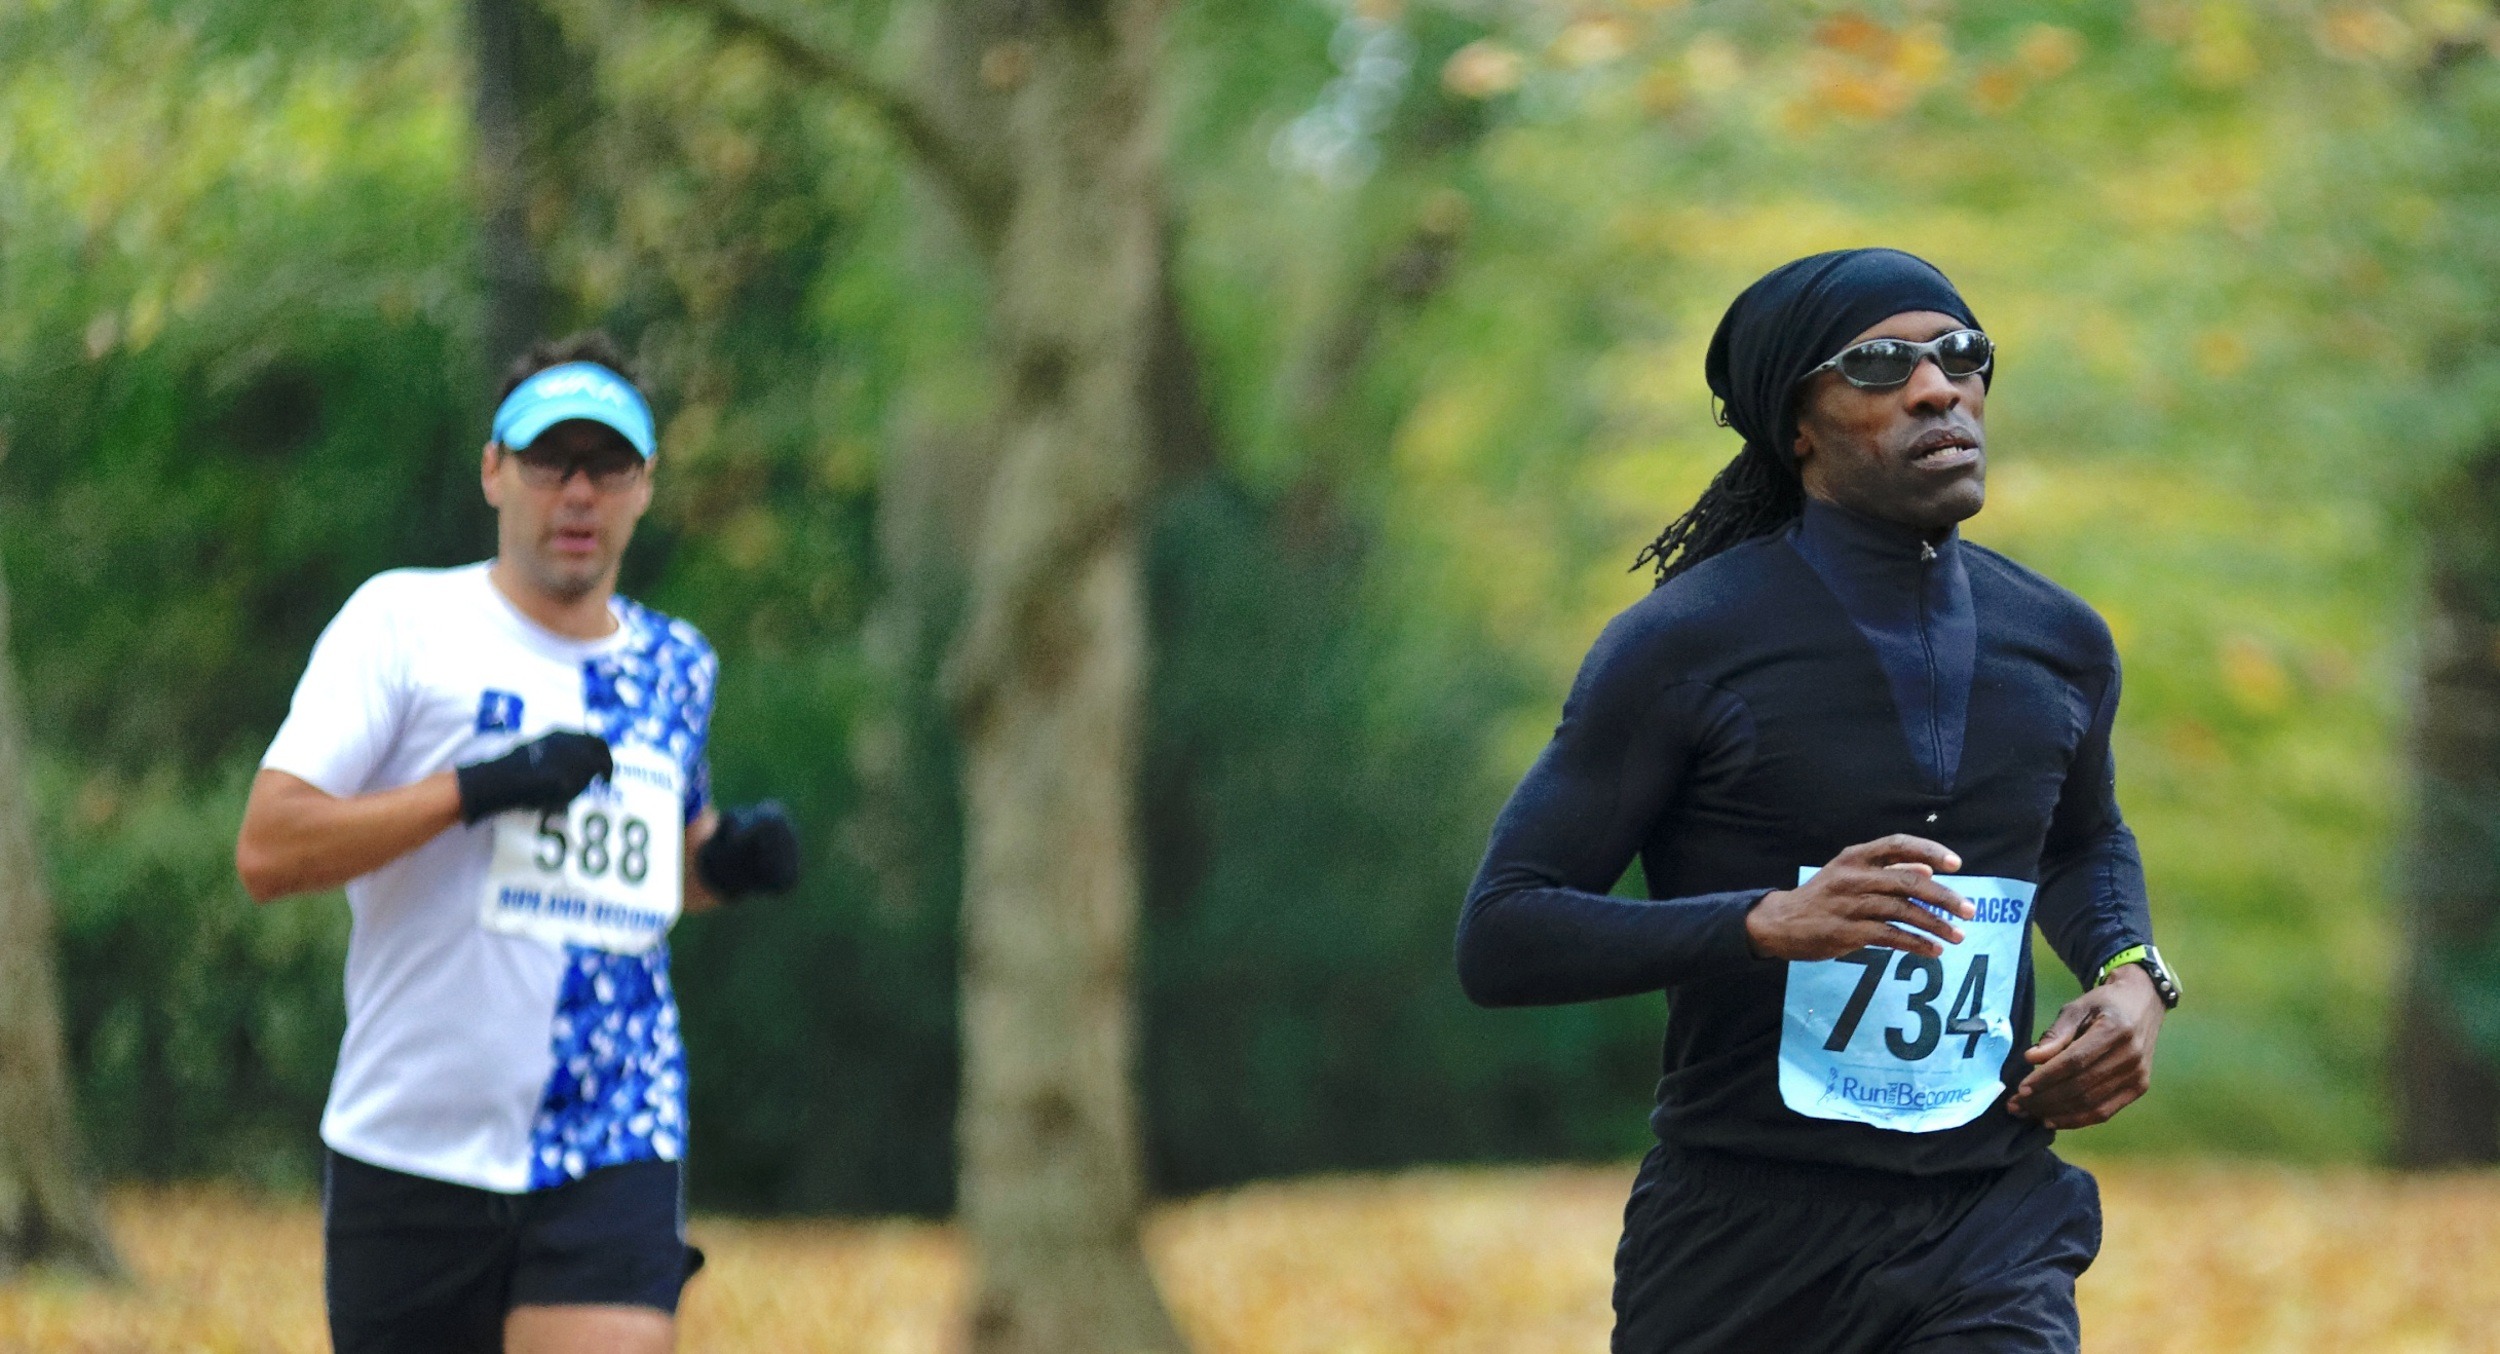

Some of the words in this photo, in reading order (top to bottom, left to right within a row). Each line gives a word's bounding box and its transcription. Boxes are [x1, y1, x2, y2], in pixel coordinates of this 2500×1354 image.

[534, 811, 649, 886] 588
[1822, 947, 1989, 1061] 734
[1842, 1077, 1887, 1104] Run
[1898, 1082, 1972, 1107] Become
